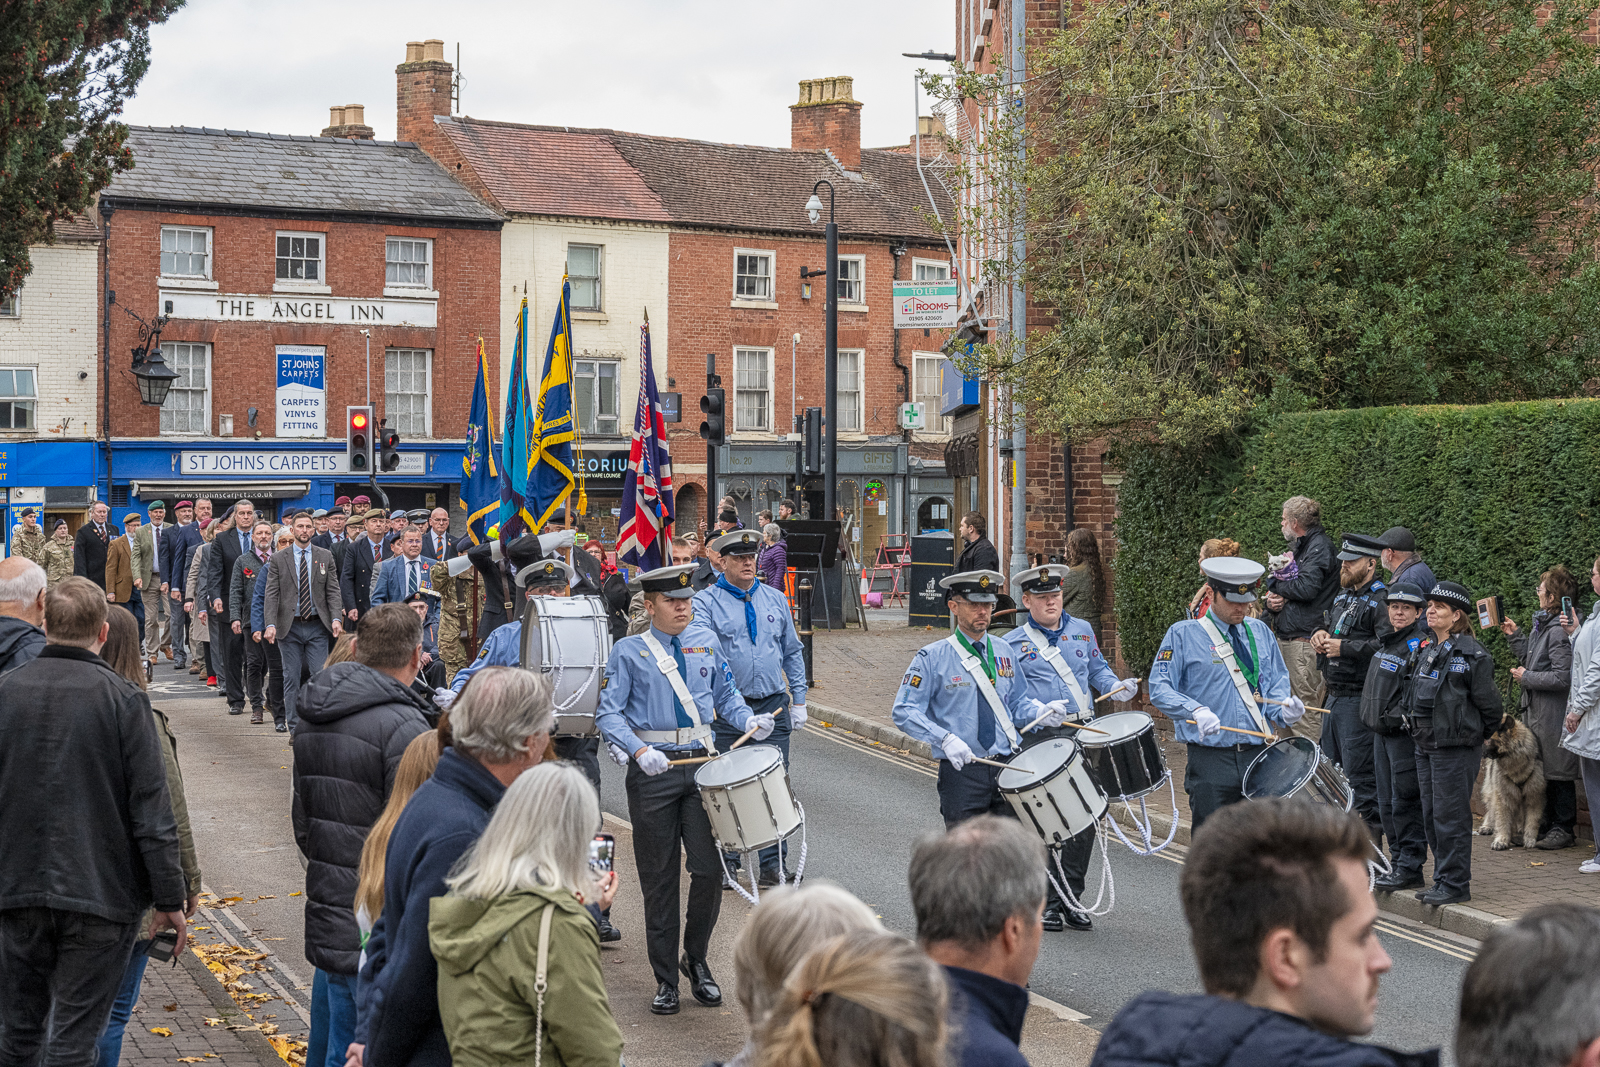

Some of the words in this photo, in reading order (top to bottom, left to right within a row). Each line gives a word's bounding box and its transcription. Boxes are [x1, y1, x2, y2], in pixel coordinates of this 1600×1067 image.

[912, 288, 923, 296] TO
[925, 287, 939, 295] LET
[216, 300, 255, 317] THE
[272, 302, 335, 319] ANGEL
[351, 305, 384, 320] INN
[916, 303, 949, 311] ROOMS
[282, 359, 292, 368] ST
[292, 360, 320, 369] JOHNS
[281, 370, 320, 378] CARPETS
[281, 398, 320, 406] CARPETS
[284, 410, 317, 418] VINYLS
[282, 422, 319, 430] FITTING
[190, 454, 208, 470] ST
[212, 455, 265, 470] JOHNS
[269, 455, 337, 470] CARPETS
[729, 457, 742, 465] No.
[743, 456, 753, 465] 20
[863, 452, 893, 464] GIFTS
